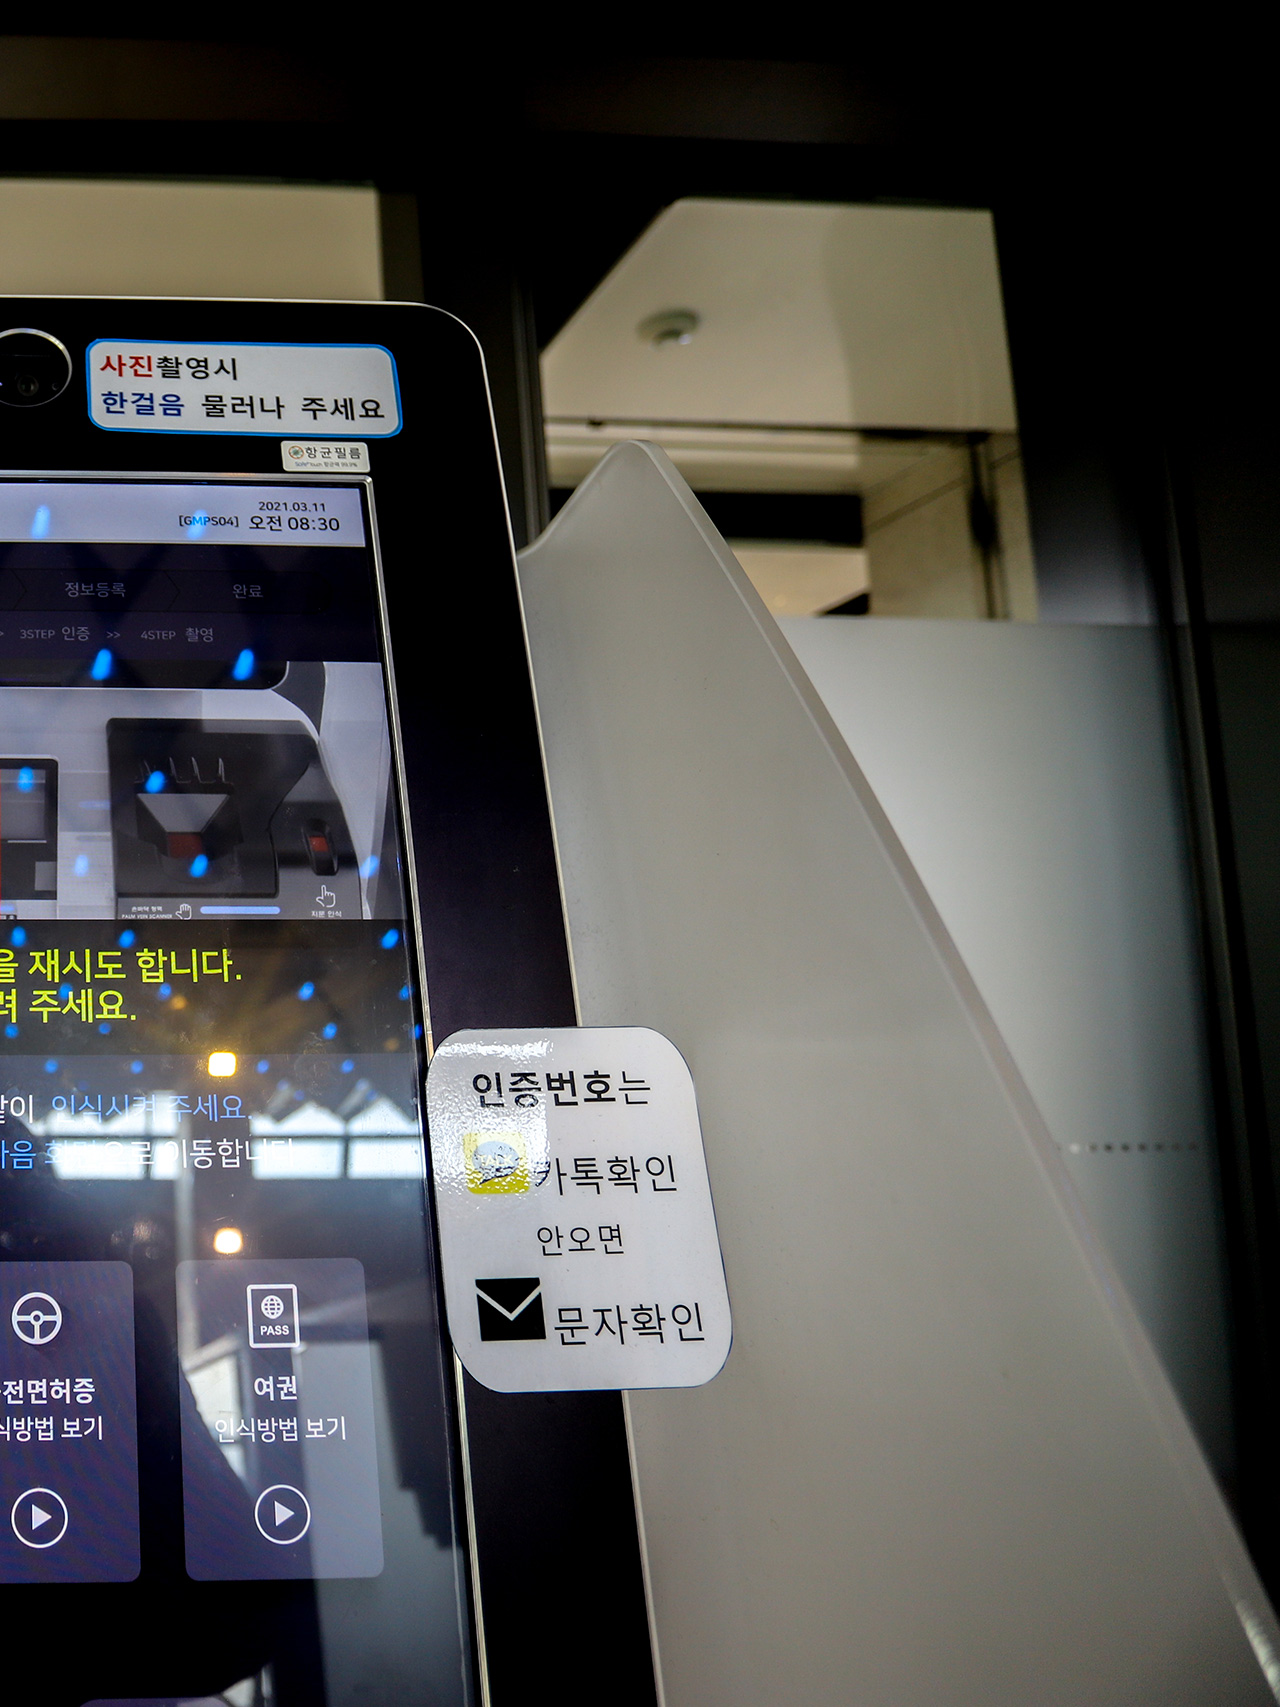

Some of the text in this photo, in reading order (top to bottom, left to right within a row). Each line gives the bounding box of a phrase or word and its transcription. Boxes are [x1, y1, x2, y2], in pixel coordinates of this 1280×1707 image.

[99, 353, 239, 381] 사진촬영시
[100, 391, 386, 421] 한걸음 물러나 주세요
[305, 446, 361, 460] 항균필름
[258, 501, 326, 512] 2021.03.11
[178, 515, 239, 528] [GMPS04]
[249, 515, 340, 532] 오전 08:30
[64, 582, 126, 598] 정보등록
[232, 584, 264, 600] 완료
[20, 626, 91, 641] 3STEP 인증
[140, 627, 214, 642] 4STEP 촬영
[28, 948, 126, 983] 재시도
[136, 948, 242, 983] 합니다.
[29, 989, 136, 1023] 주세요.
[472, 1069, 651, 1109] 인증번호는
[168, 1094, 253, 1123] 주세요.
[536, 1223, 624, 1256] 안오면
[259, 1324, 290, 1337] PASS
[554, 1302, 705, 1345] 문자확인
[253, 1375, 298, 1402] 여권
[61, 1416, 104, 1441] 보기
[214, 1415, 347, 1442] 인식방법 보기
